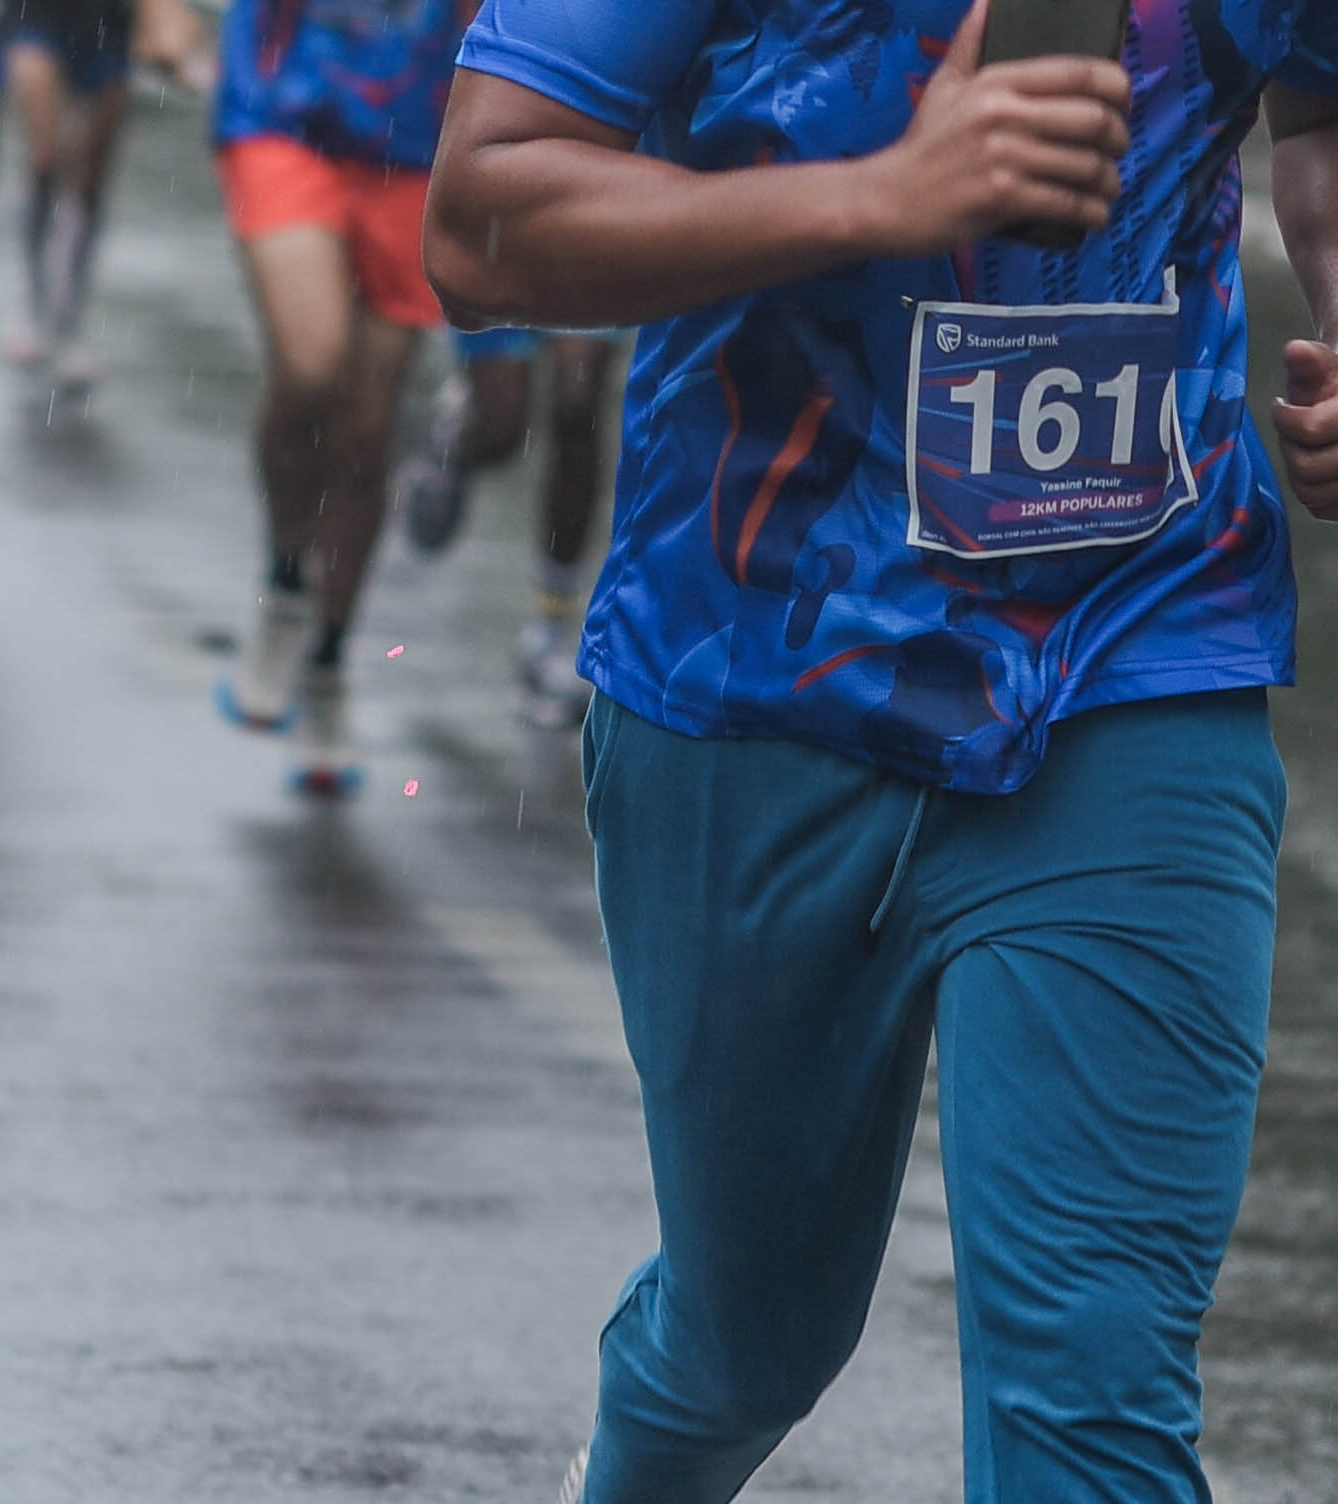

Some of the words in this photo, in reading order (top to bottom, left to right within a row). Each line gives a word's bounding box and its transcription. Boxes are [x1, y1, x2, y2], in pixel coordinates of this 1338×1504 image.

[966, 333, 1025, 348] Standard
[1028, 334, 1059, 347] Bank
[950, 364, 1139, 474] 161
[1020, 500, 1057, 517] 12KM
[1060, 494, 1143, 513] POPULARES
